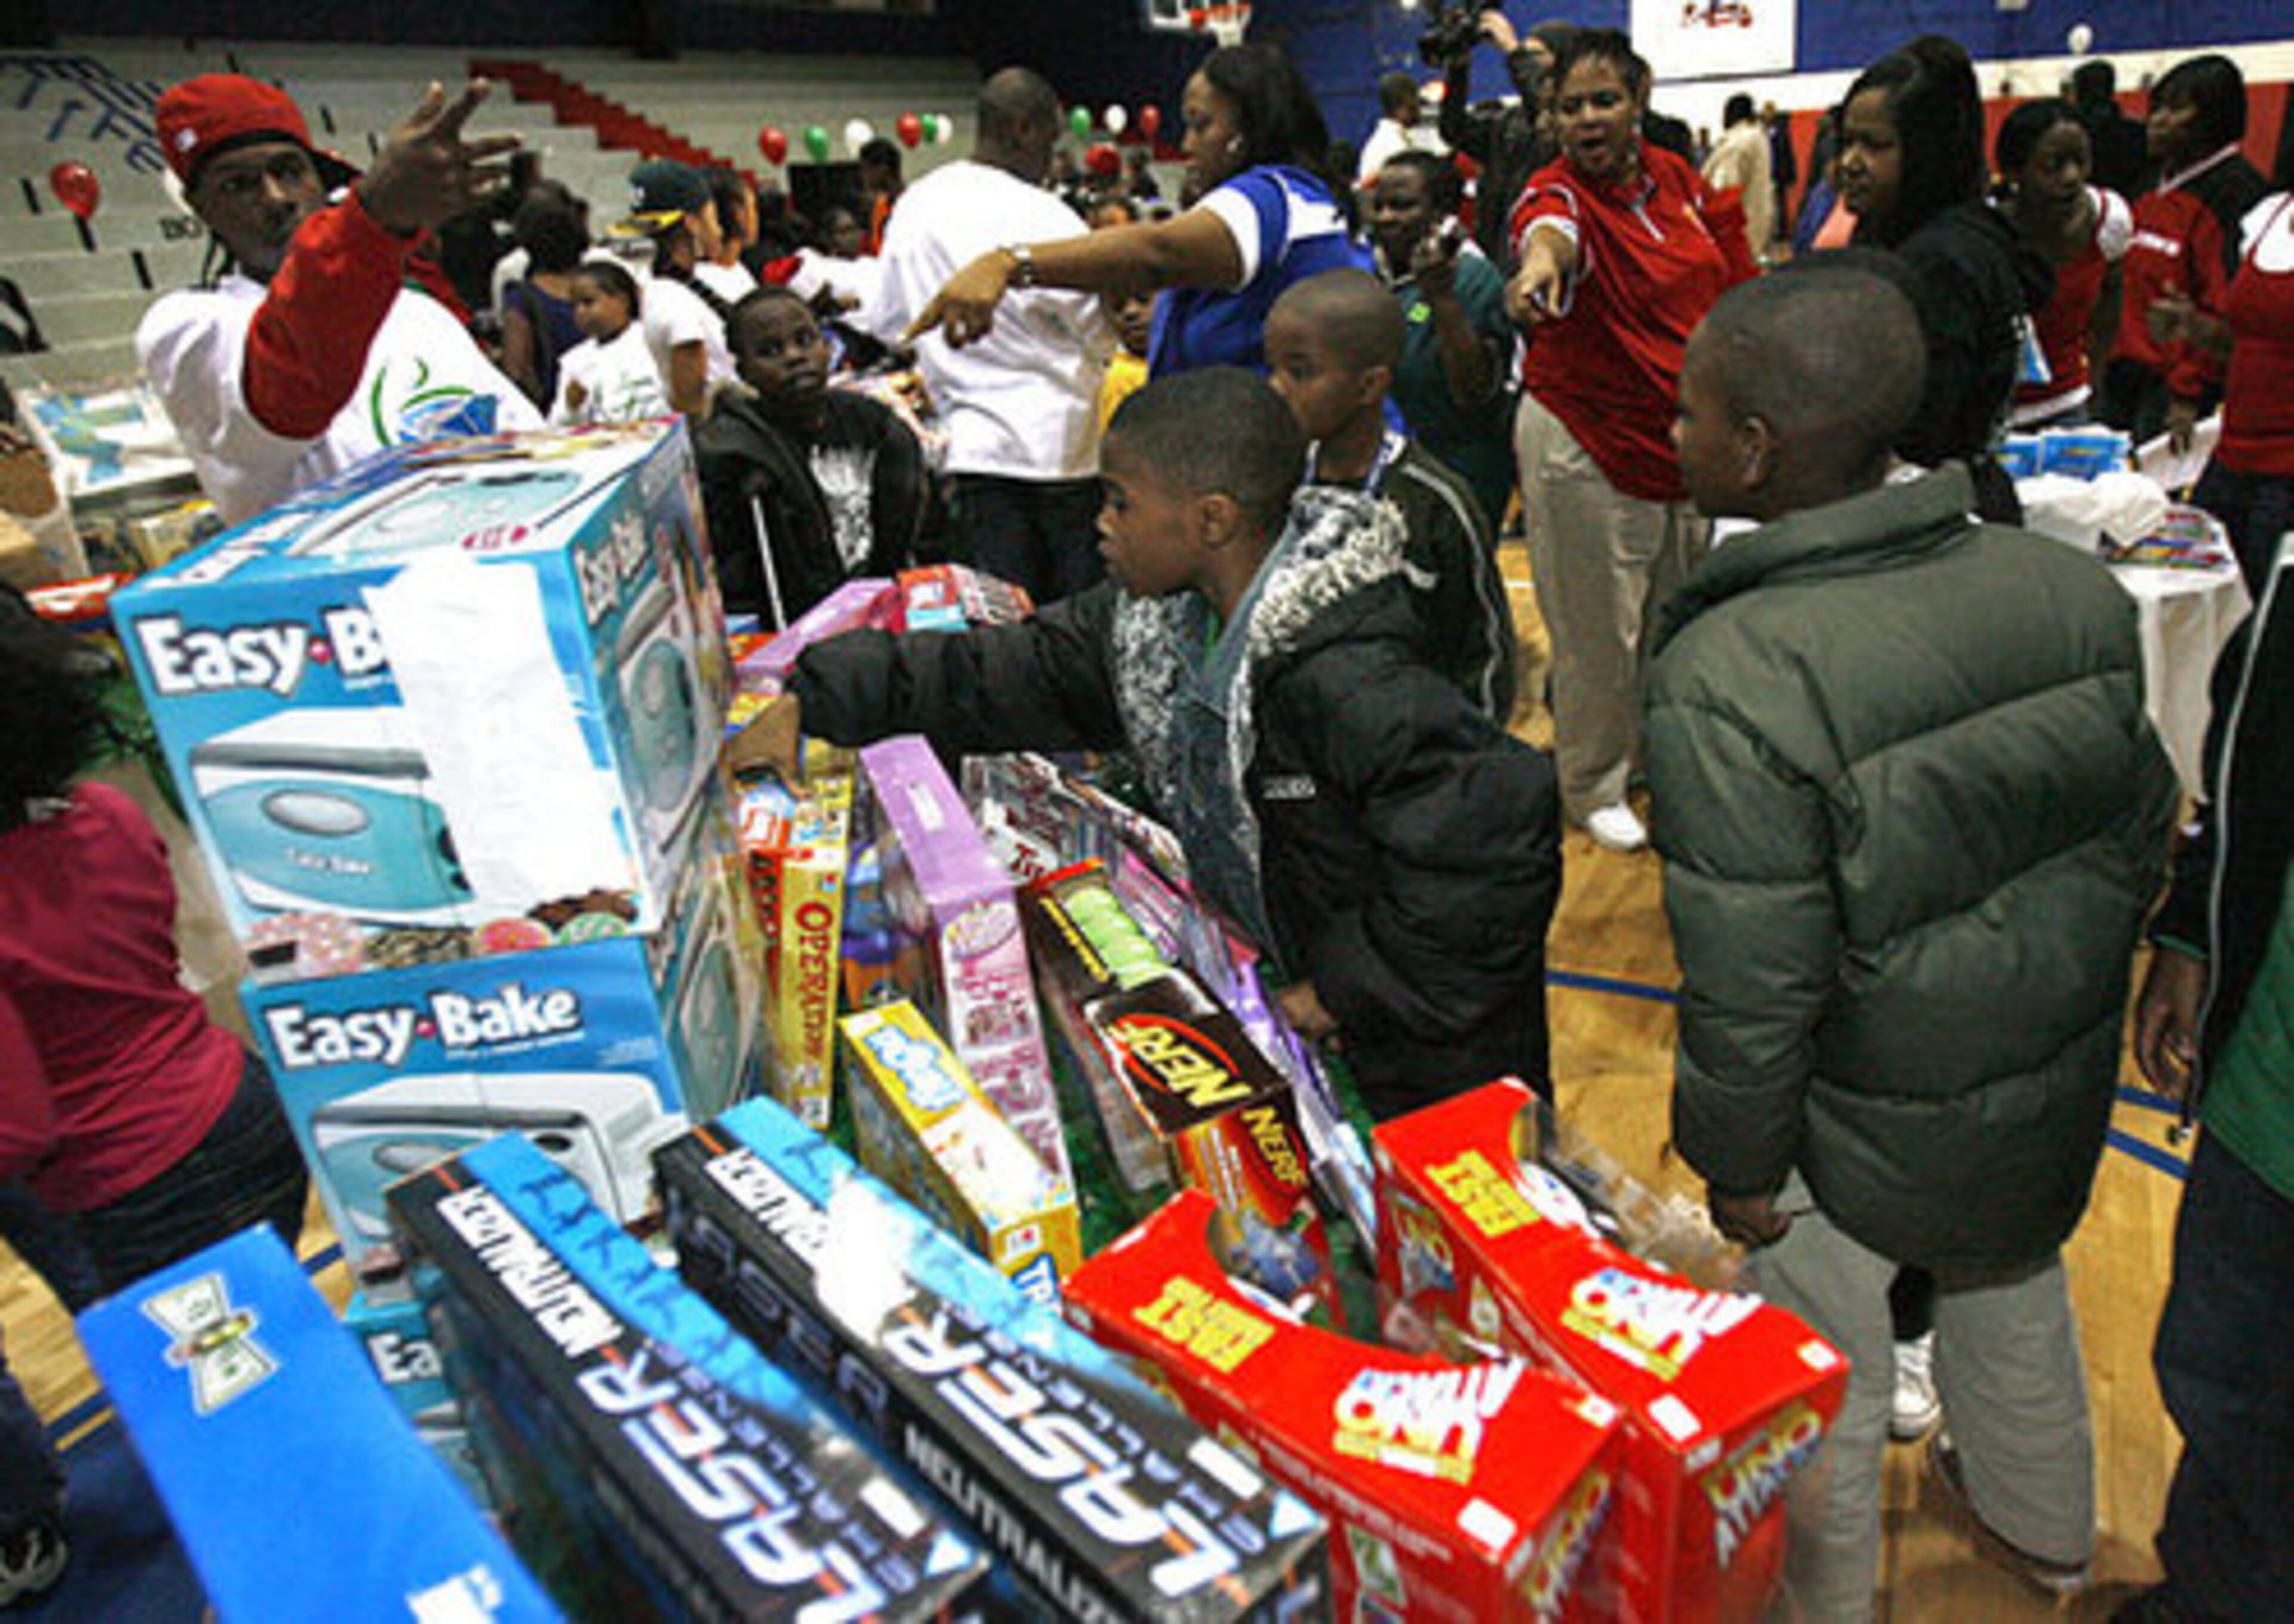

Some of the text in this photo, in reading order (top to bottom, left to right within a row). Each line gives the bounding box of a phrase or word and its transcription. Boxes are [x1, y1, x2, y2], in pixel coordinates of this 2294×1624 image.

[133, 613, 309, 699] Easy
[265, 1003, 415, 1071] Easy
[431, 981, 583, 1050] Bake
[1106, 1019, 1252, 1109] NERF
[575, 1350, 886, 1624] LASER
[880, 1313, 1241, 1597] LASER
[905, 1418, 1129, 1624] NEUTRALIZ
